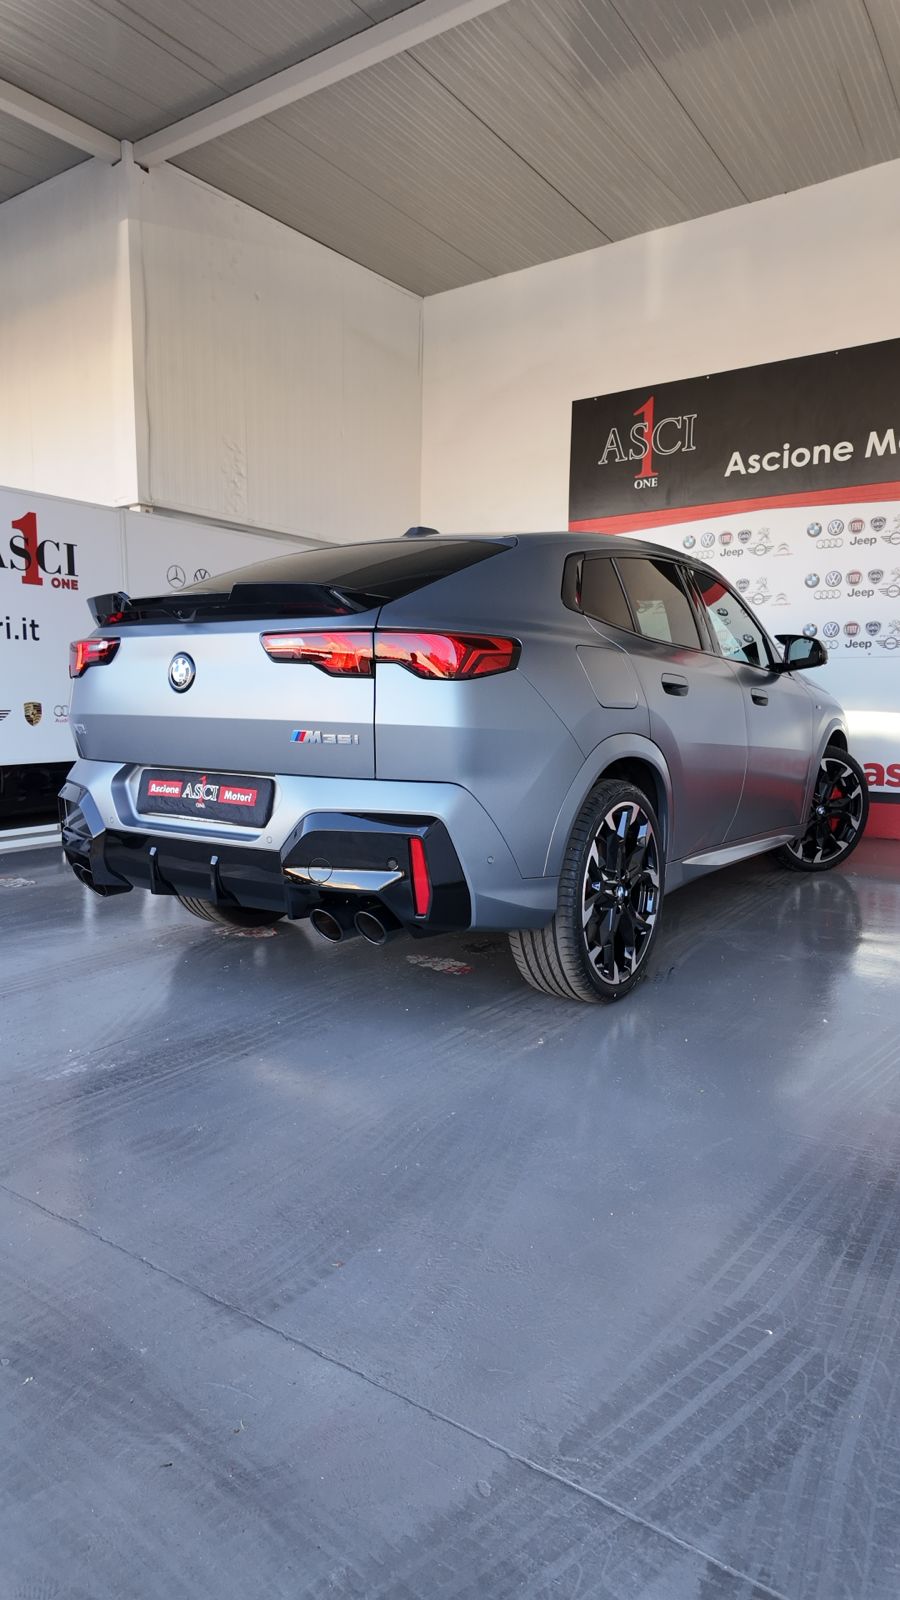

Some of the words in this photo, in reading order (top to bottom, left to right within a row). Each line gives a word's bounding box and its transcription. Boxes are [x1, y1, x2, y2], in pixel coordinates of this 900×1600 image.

[598, 414, 697, 465] ASCI
[723, 441, 855, 478] Ascione
[864, 428, 900, 459] M
[633, 477, 659, 490] ONE
[849, 536, 877, 546] Jeep
[719, 548, 743, 557] Jeep
[51, 577, 79, 590] ONE
[847, 588, 874, 598] Jeep
[845, 639, 872, 649] Jeep
[303, 730, 359, 745] M35i
[150, 783, 180, 794] Ascione
[182, 782, 219, 802] ASCI
[223, 790, 253, 803] Motori
